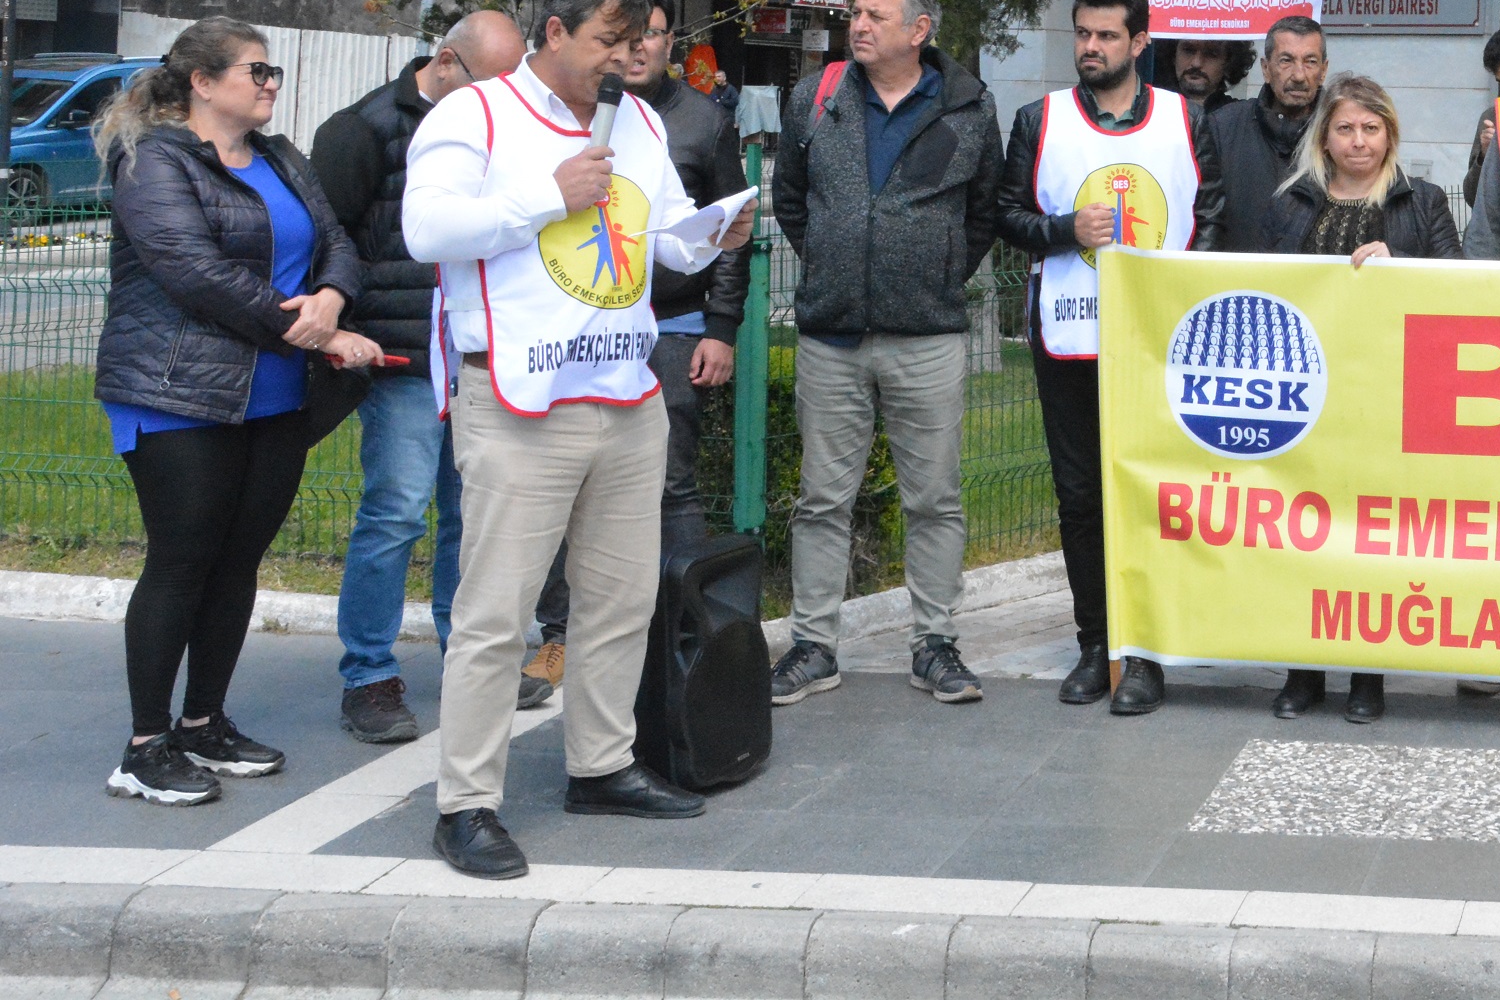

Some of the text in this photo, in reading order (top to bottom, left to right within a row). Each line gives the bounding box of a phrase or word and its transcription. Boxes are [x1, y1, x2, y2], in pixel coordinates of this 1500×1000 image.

[1113, 179, 1129, 189] BES
[548, 258, 572, 288] BÜRO
[1055, 294, 1077, 322] BÜRO
[528, 337, 564, 374] BÜRO
[1180, 373, 1310, 412] KESK
[1217, 425, 1270, 448] 1995
[1157, 471, 1332, 551] BÜRO
